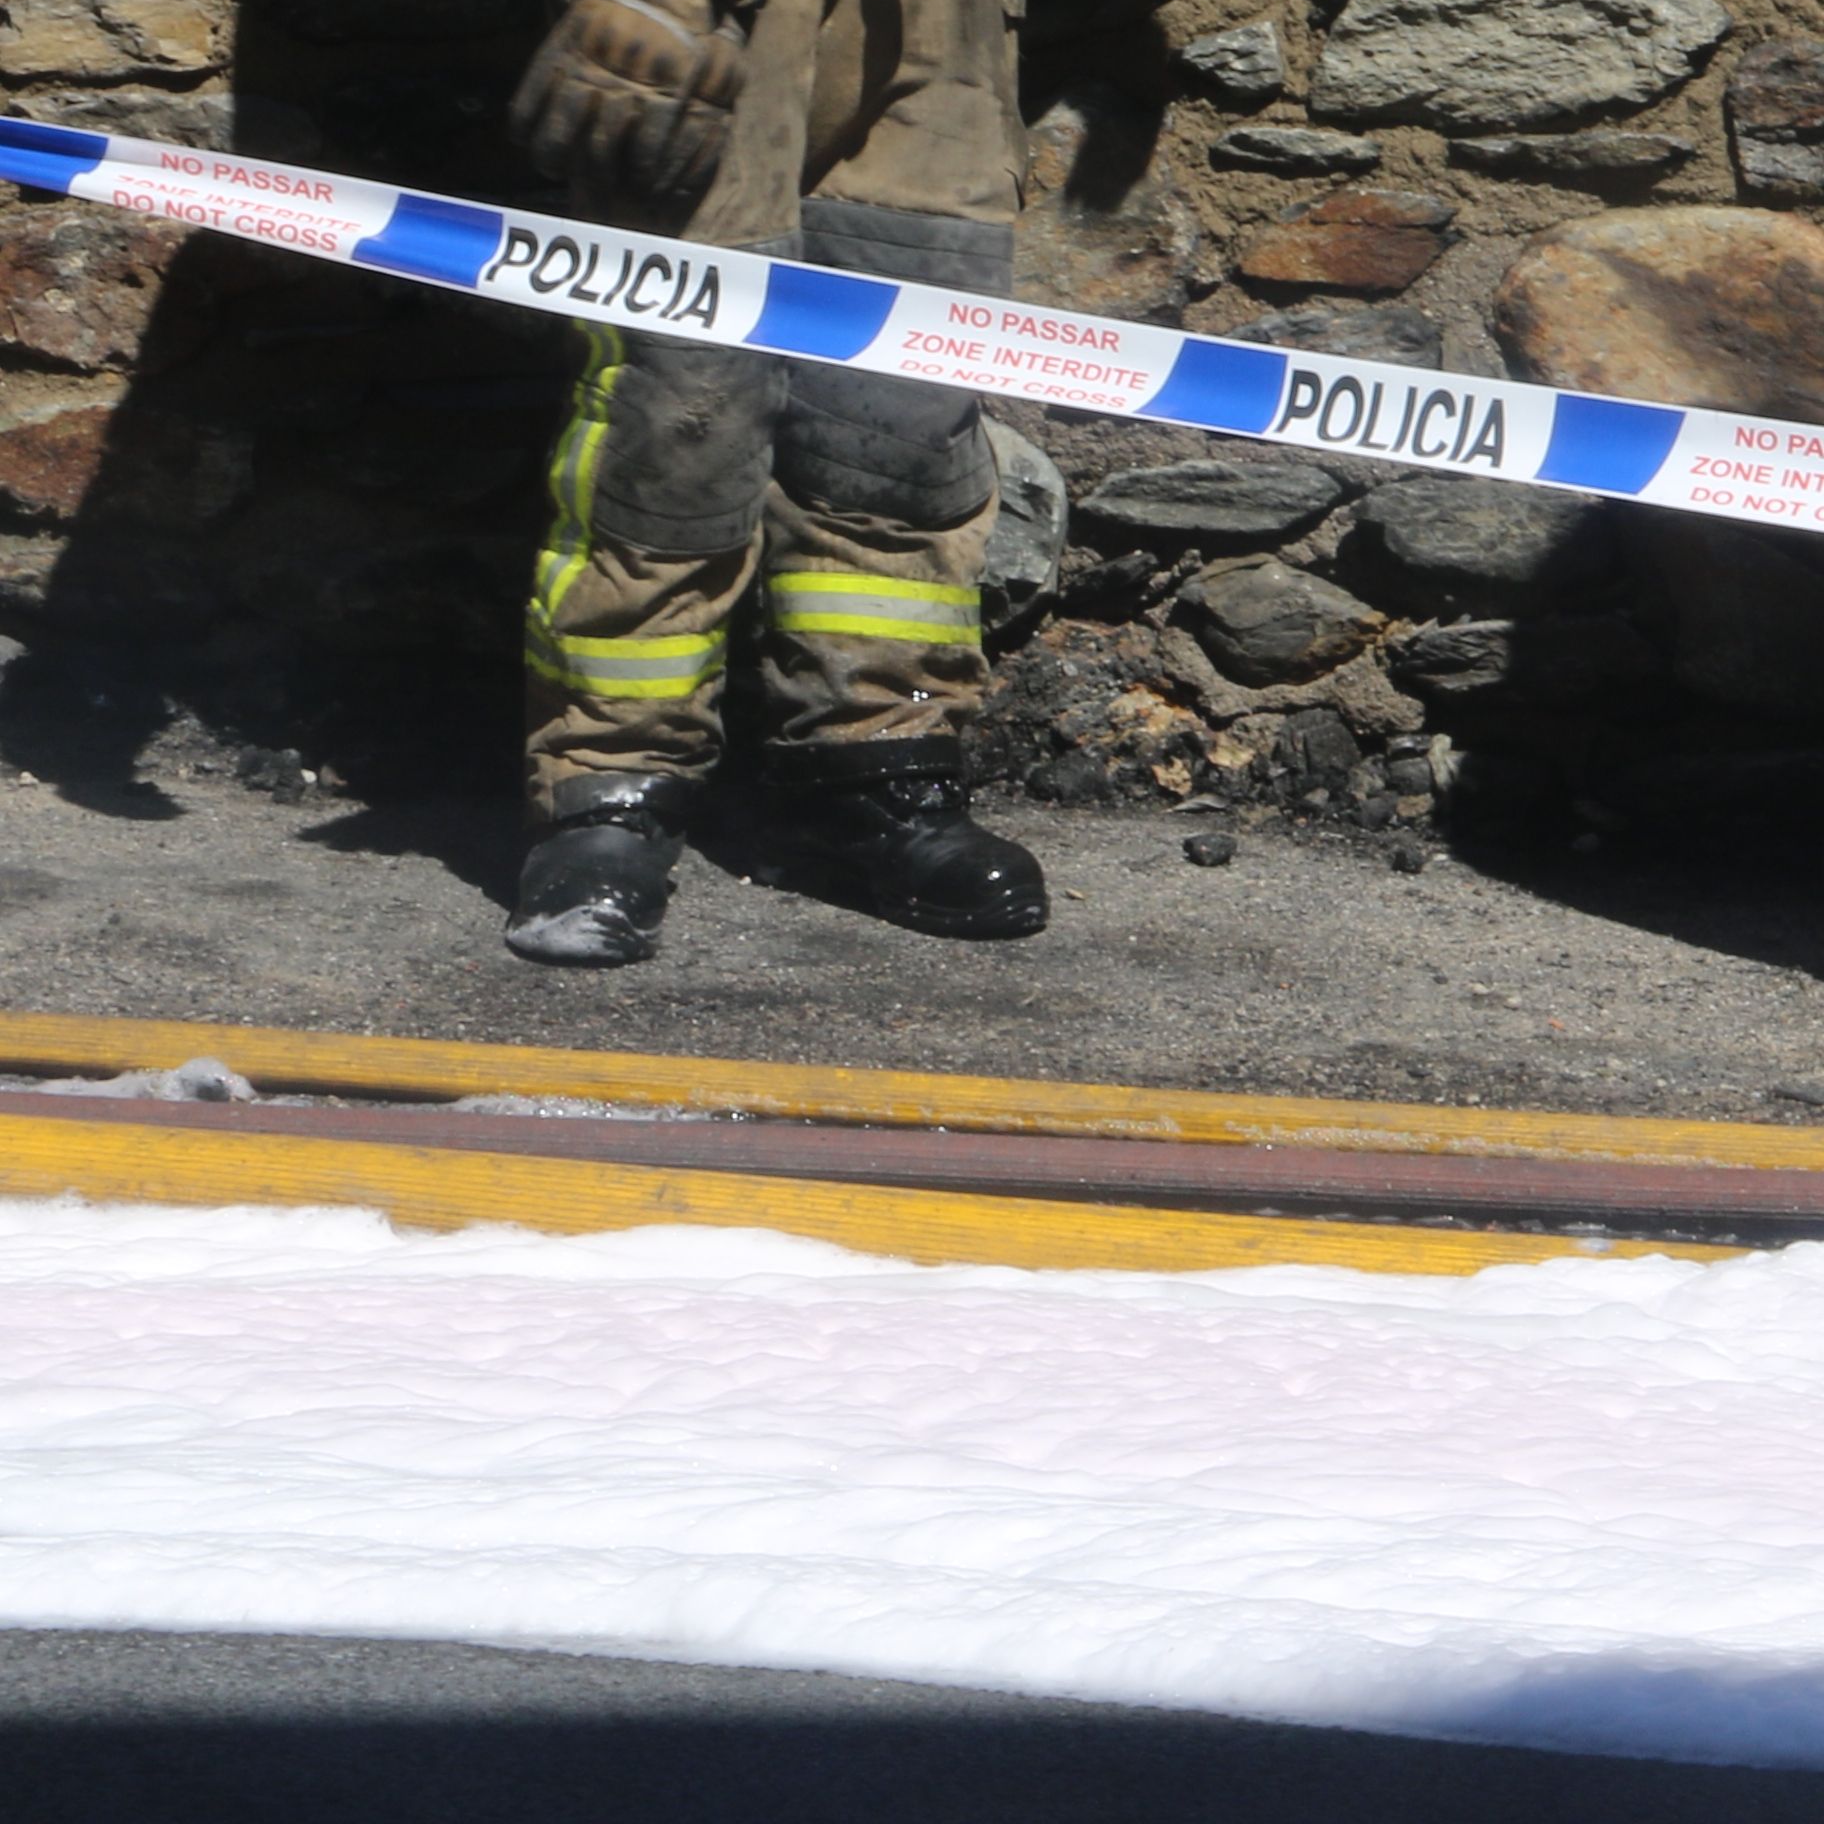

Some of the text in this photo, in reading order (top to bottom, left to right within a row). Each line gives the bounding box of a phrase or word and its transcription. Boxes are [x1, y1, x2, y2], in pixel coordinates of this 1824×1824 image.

[161, 152, 334, 203] NO PASSAR
[113, 190, 338, 252] DO NOT CROSS
[484, 227, 719, 329] POLICIA
[948, 302, 1121, 353] NO PASSAR
[899, 359, 1127, 408] DO NOT CROSS
[902, 330, 1149, 391] ZONE INTERDITE
[1274, 369, 1505, 469] POLICIA
[1734, 426, 1778, 451] NO
[1690, 456, 1774, 485] ZONE
[1690, 486, 1734, 505] DO
[1742, 495, 1807, 516] NOT
